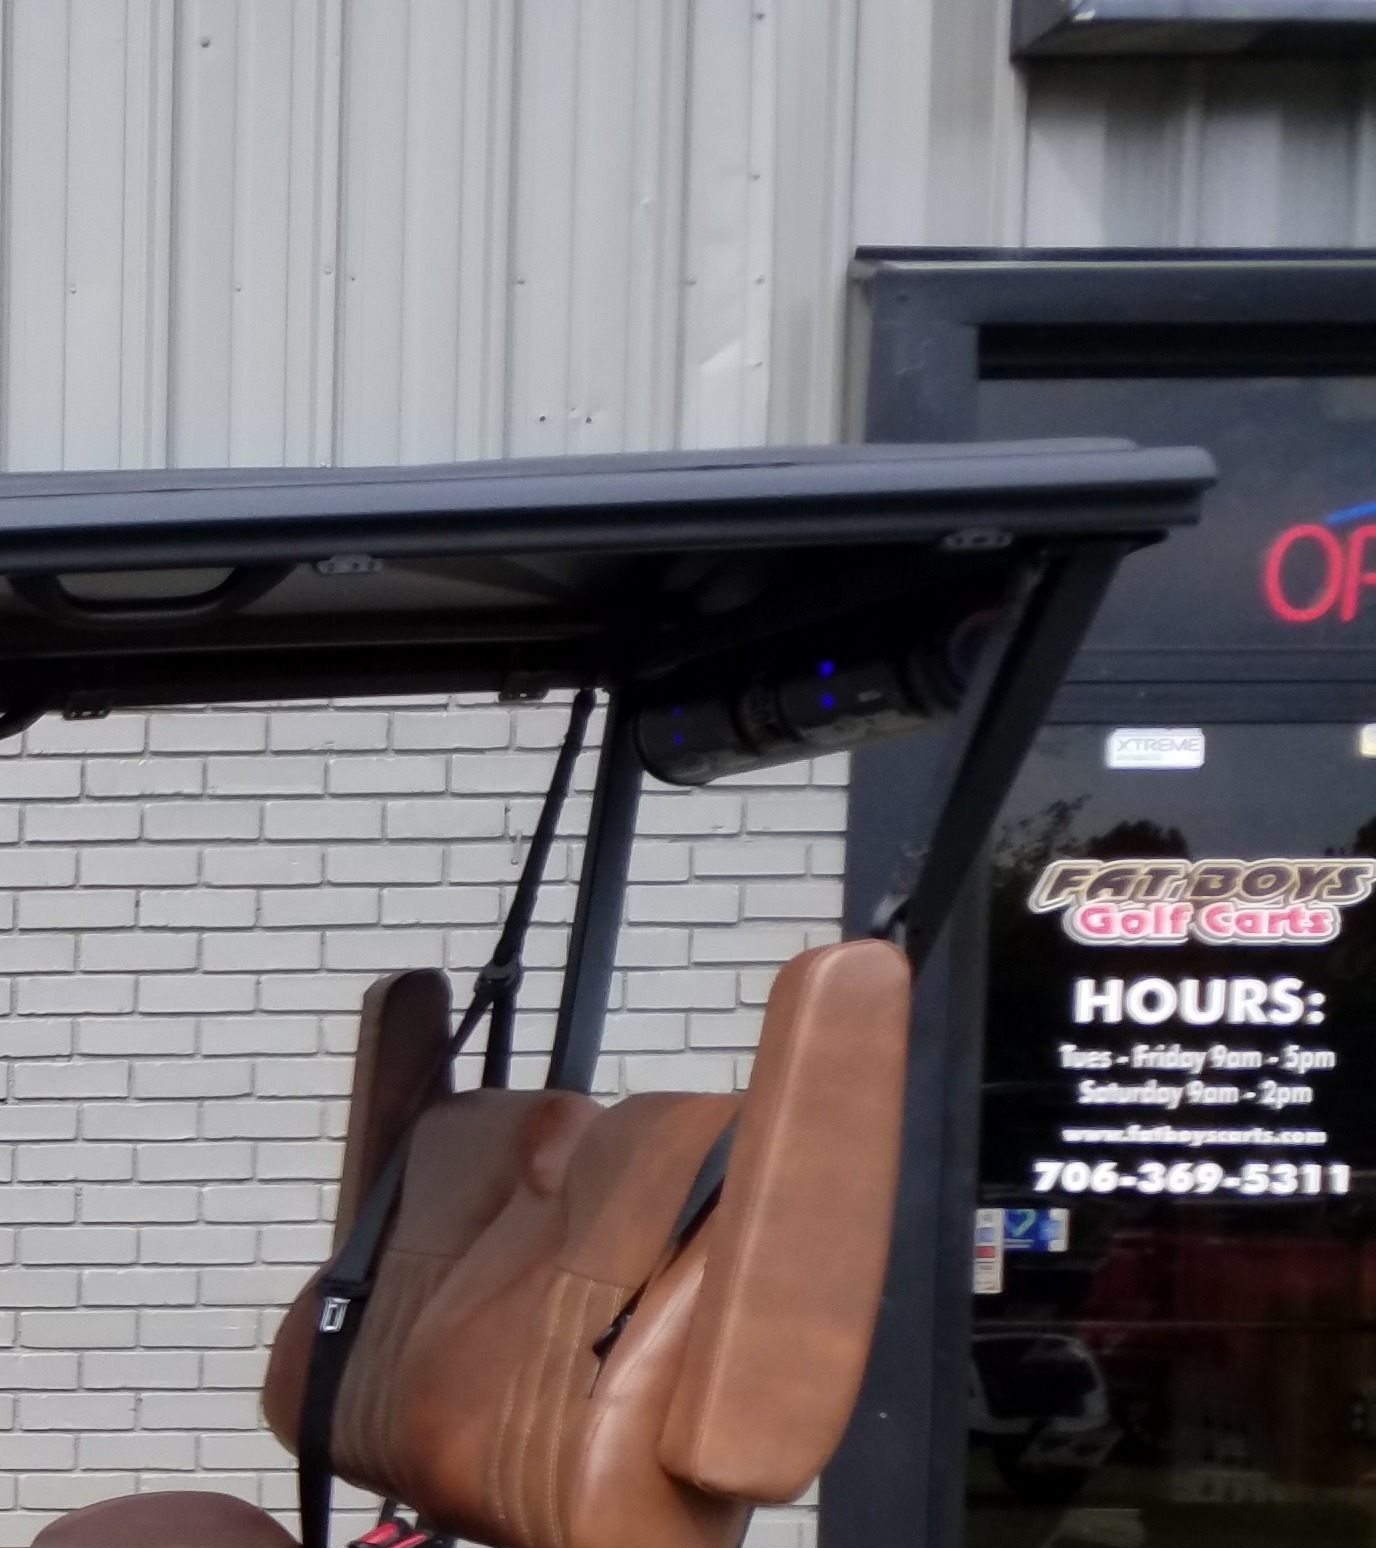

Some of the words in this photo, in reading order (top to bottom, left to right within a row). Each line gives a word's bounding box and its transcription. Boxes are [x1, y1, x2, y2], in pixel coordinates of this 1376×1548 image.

[1115, 737, 1200, 752] XTREME
[1075, 901, 1193, 938] Golf
[1200, 899, 1336, 938] Carts
[1072, 976, 1326, 1025] HOURS:
[1131, 1044, 1206, 1075] Friday
[1207, 1044, 1263, 1069] 9am
[1281, 1044, 1336, 1075] 5pm
[1078, 1079, 1183, 1110] Saturday
[1184, 1080, 1240, 1105] 9am
[1258, 1080, 1314, 1110] 2pm
[1033, 1161, 1350, 1195] 706-369-5311
